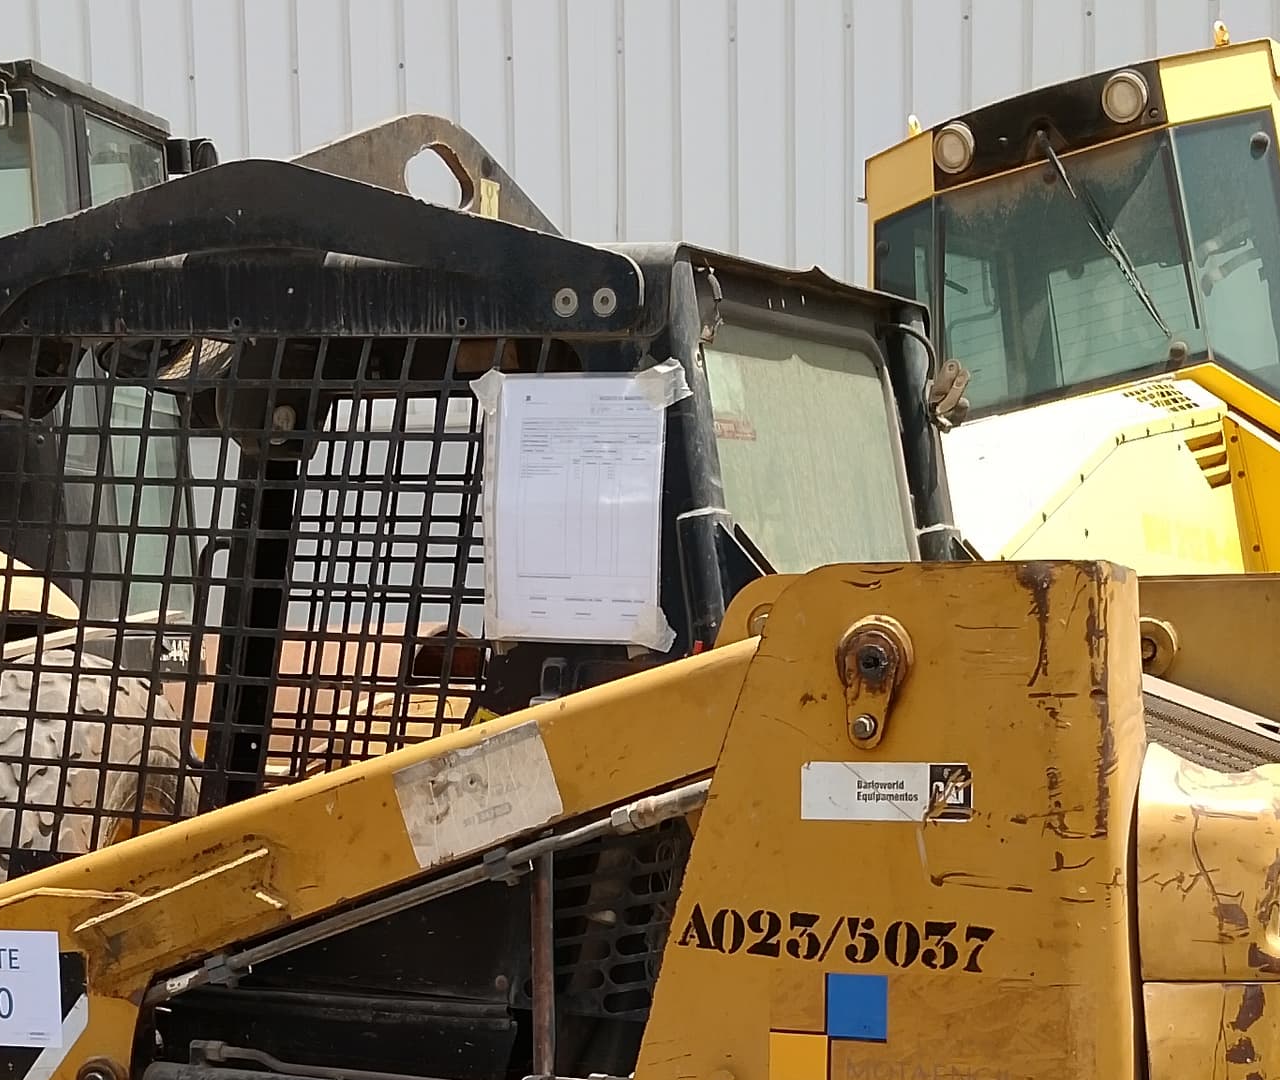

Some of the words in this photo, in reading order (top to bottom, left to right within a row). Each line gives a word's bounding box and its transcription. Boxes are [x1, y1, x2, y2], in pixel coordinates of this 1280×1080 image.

[856, 779, 905, 790] Barloworld
[856, 791, 919, 803] Equipamentos
[675, 902, 996, 974] A023/5037
